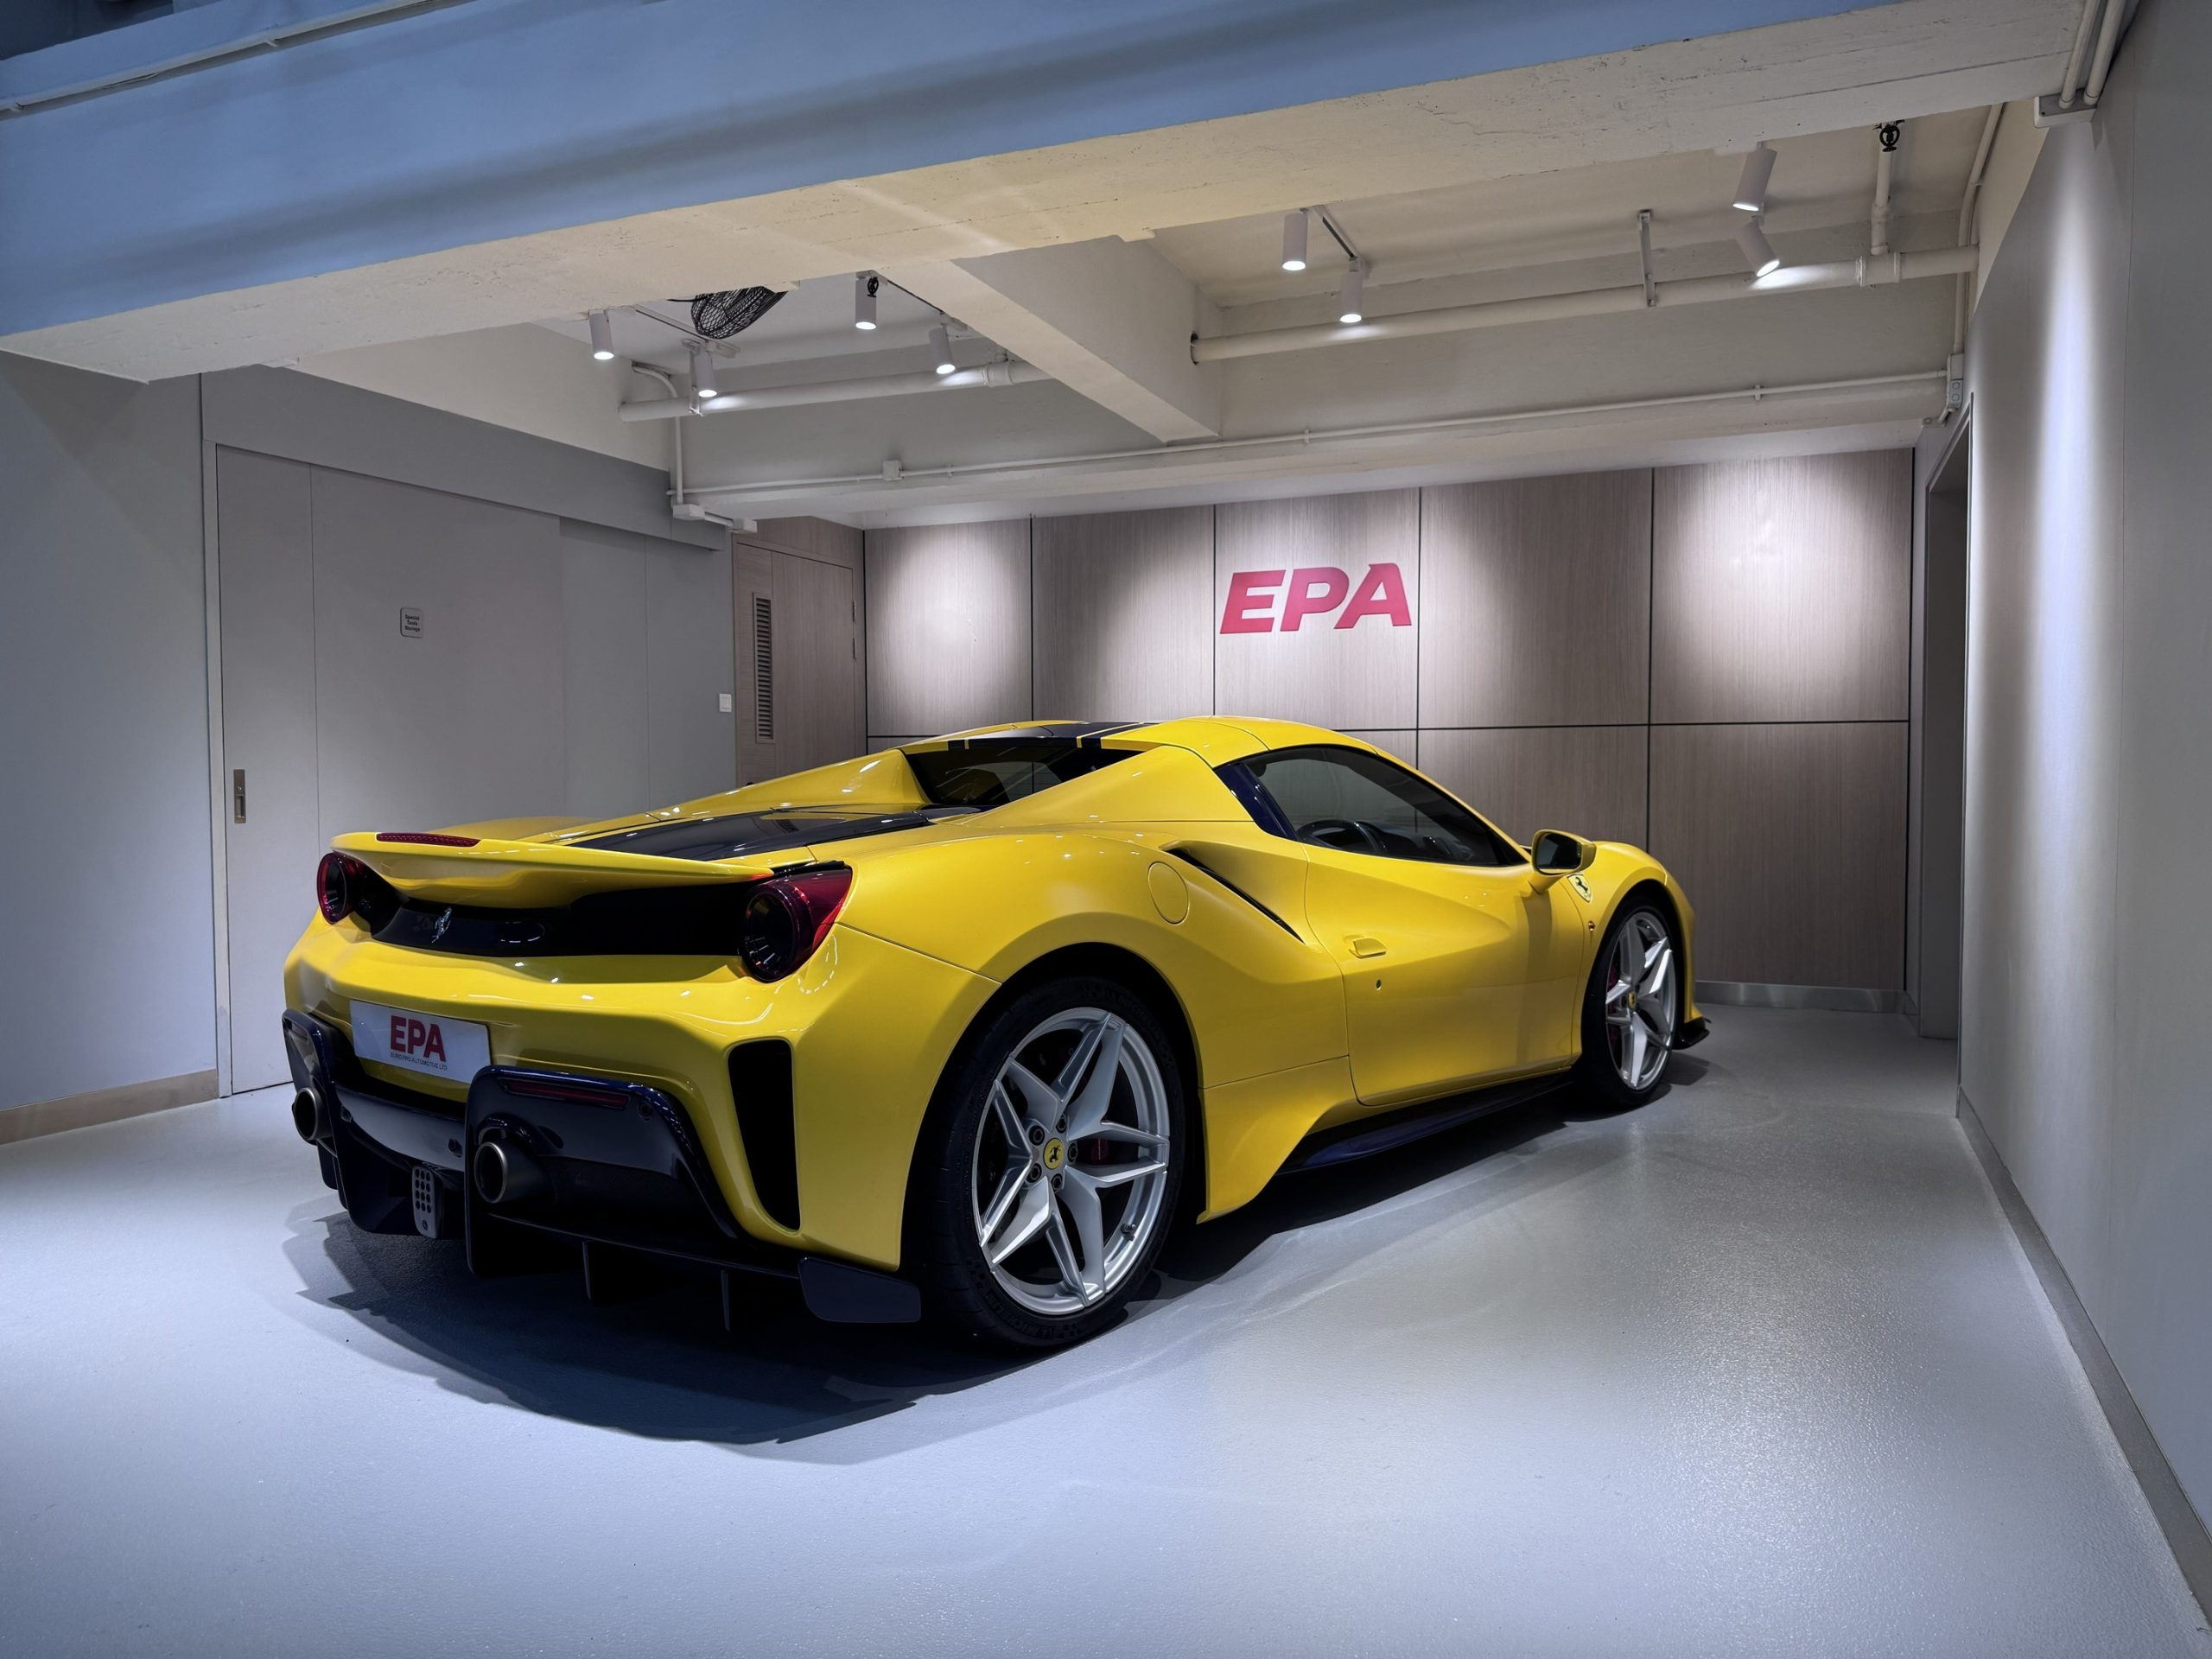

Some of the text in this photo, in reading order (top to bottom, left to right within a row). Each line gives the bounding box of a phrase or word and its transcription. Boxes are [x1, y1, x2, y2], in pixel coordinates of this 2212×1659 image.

[1219, 563, 1413, 634] EPA
[391, 1015, 446, 1062] EPA
[391, 1052, 402, 1060] EURO
[411, 1058, 439, 1068] AUTOMOTIVE
